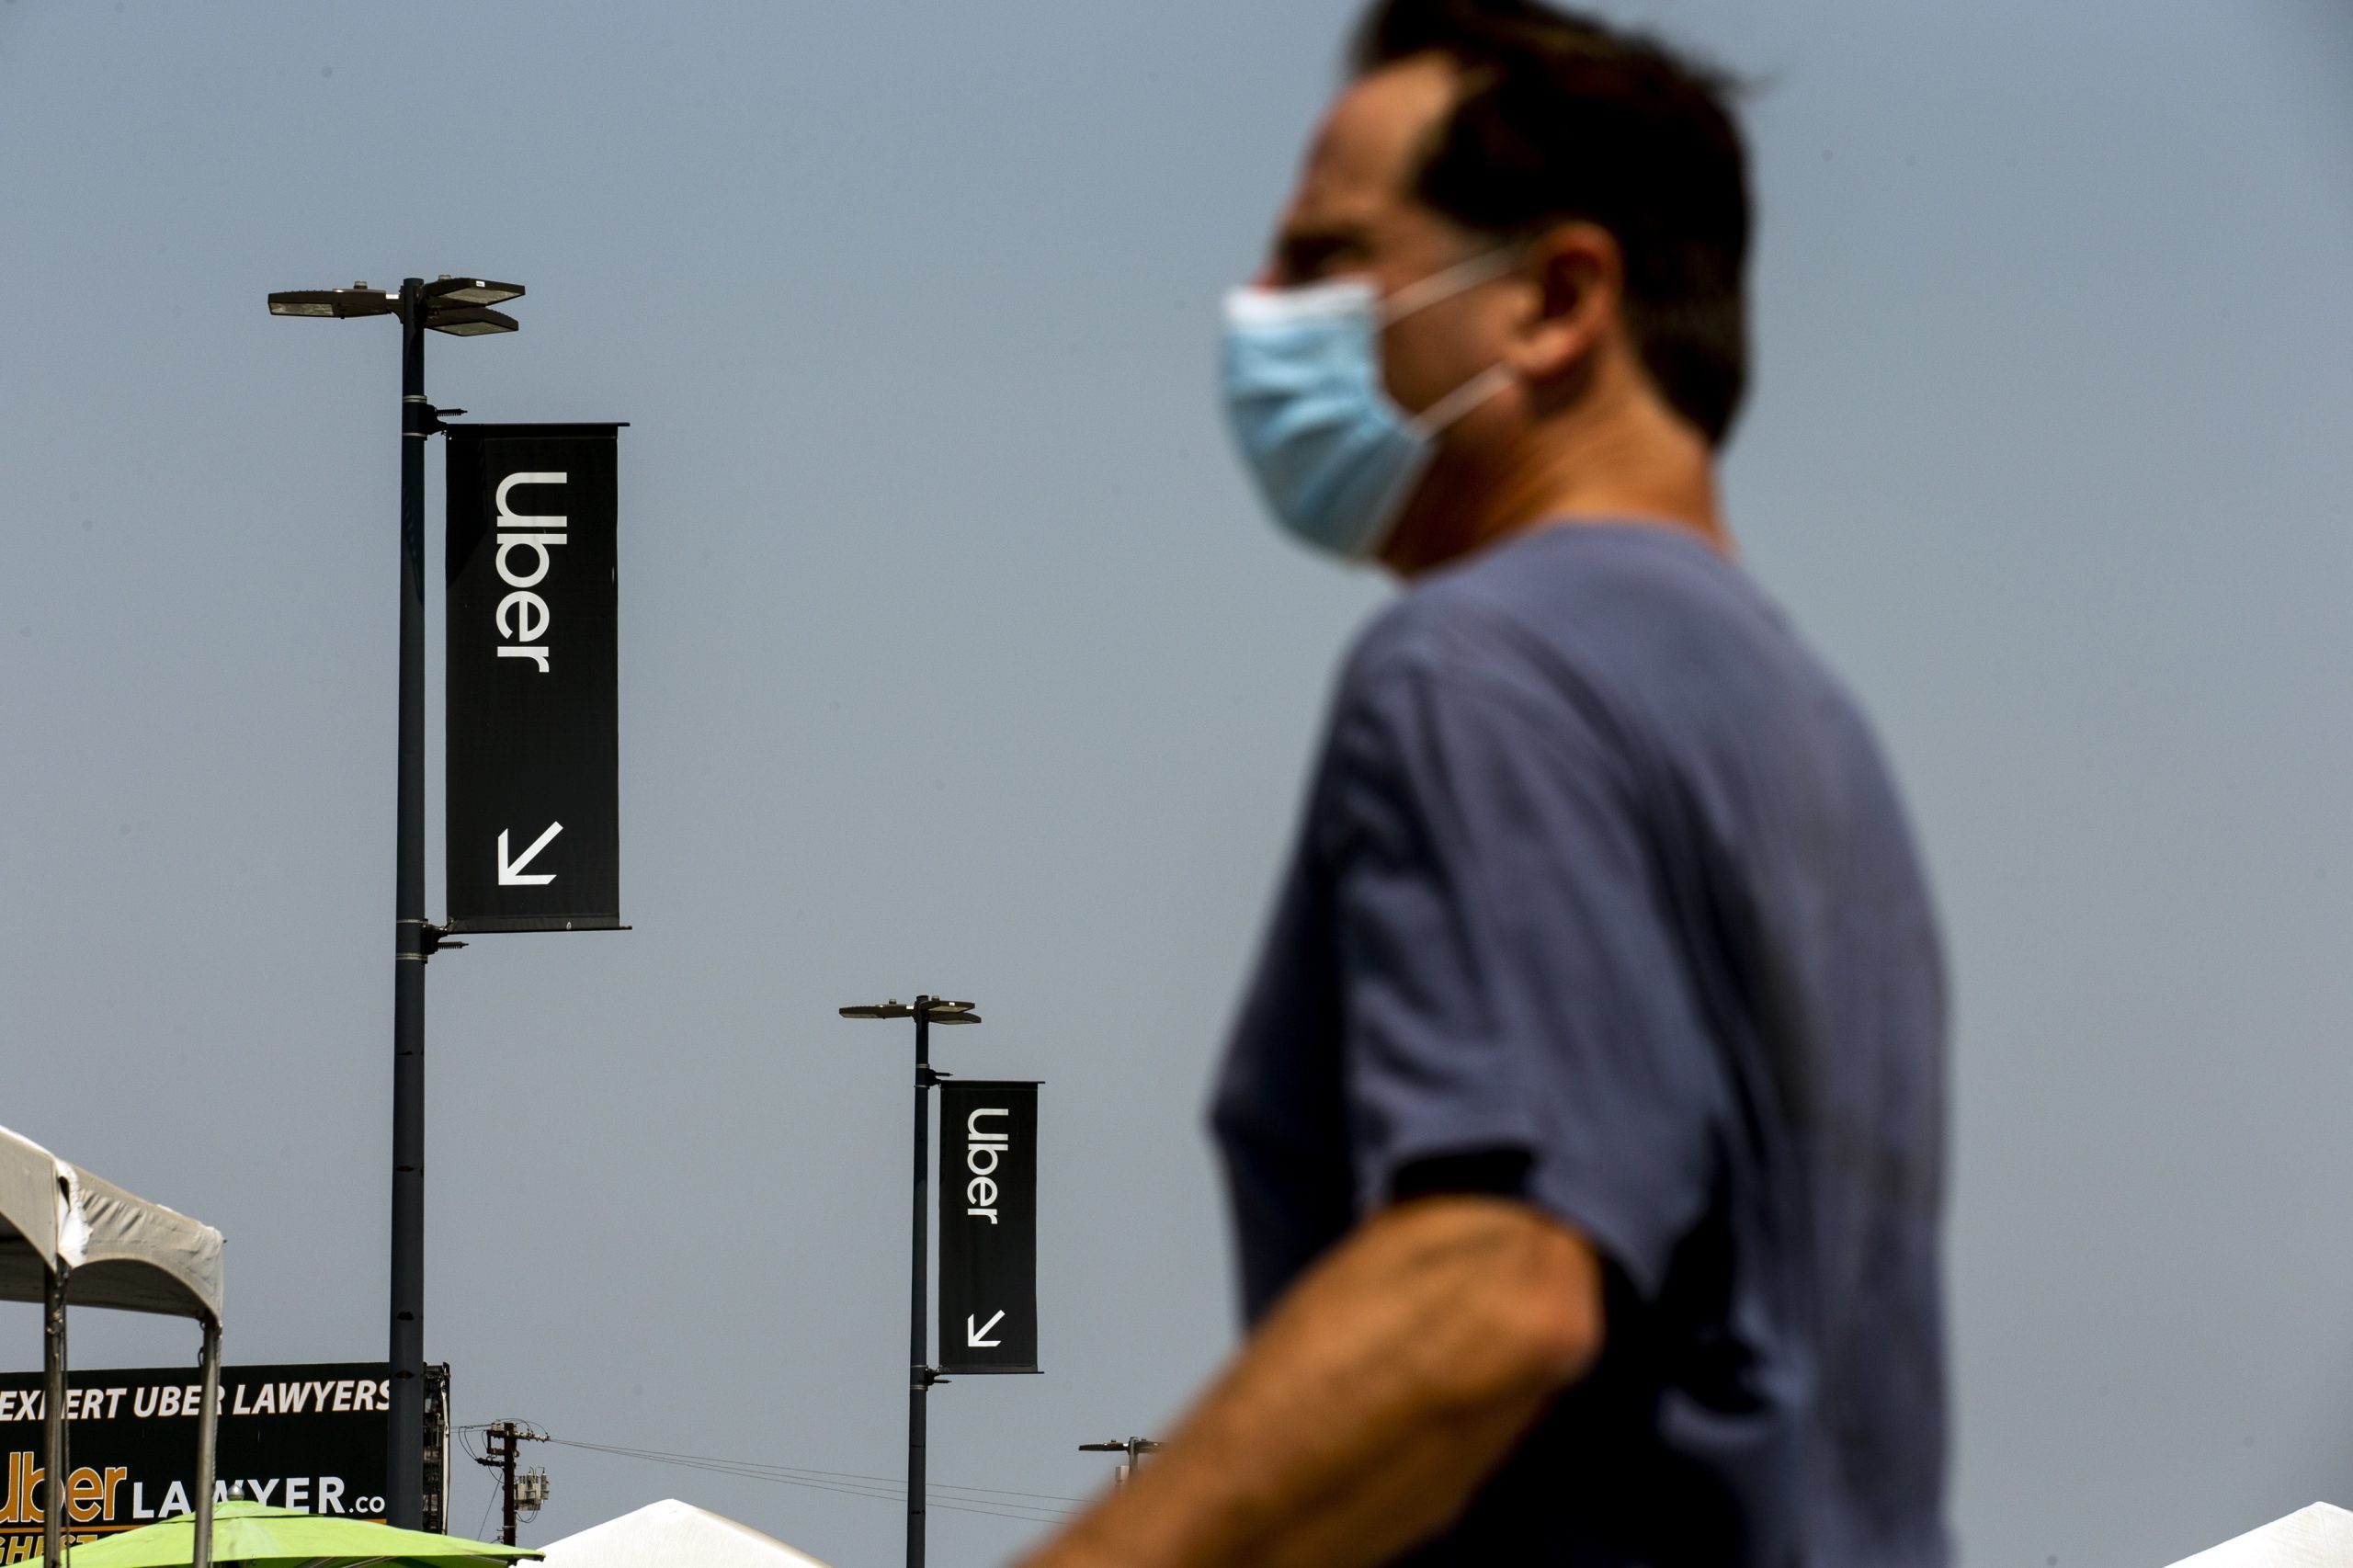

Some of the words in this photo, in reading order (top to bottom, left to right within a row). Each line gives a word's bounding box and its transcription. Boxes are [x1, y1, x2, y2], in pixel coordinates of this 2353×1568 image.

[495, 472, 568, 673] Uber
[967, 1108, 1009, 1224] Uber
[0, 1388, 128, 1421] EXERT
